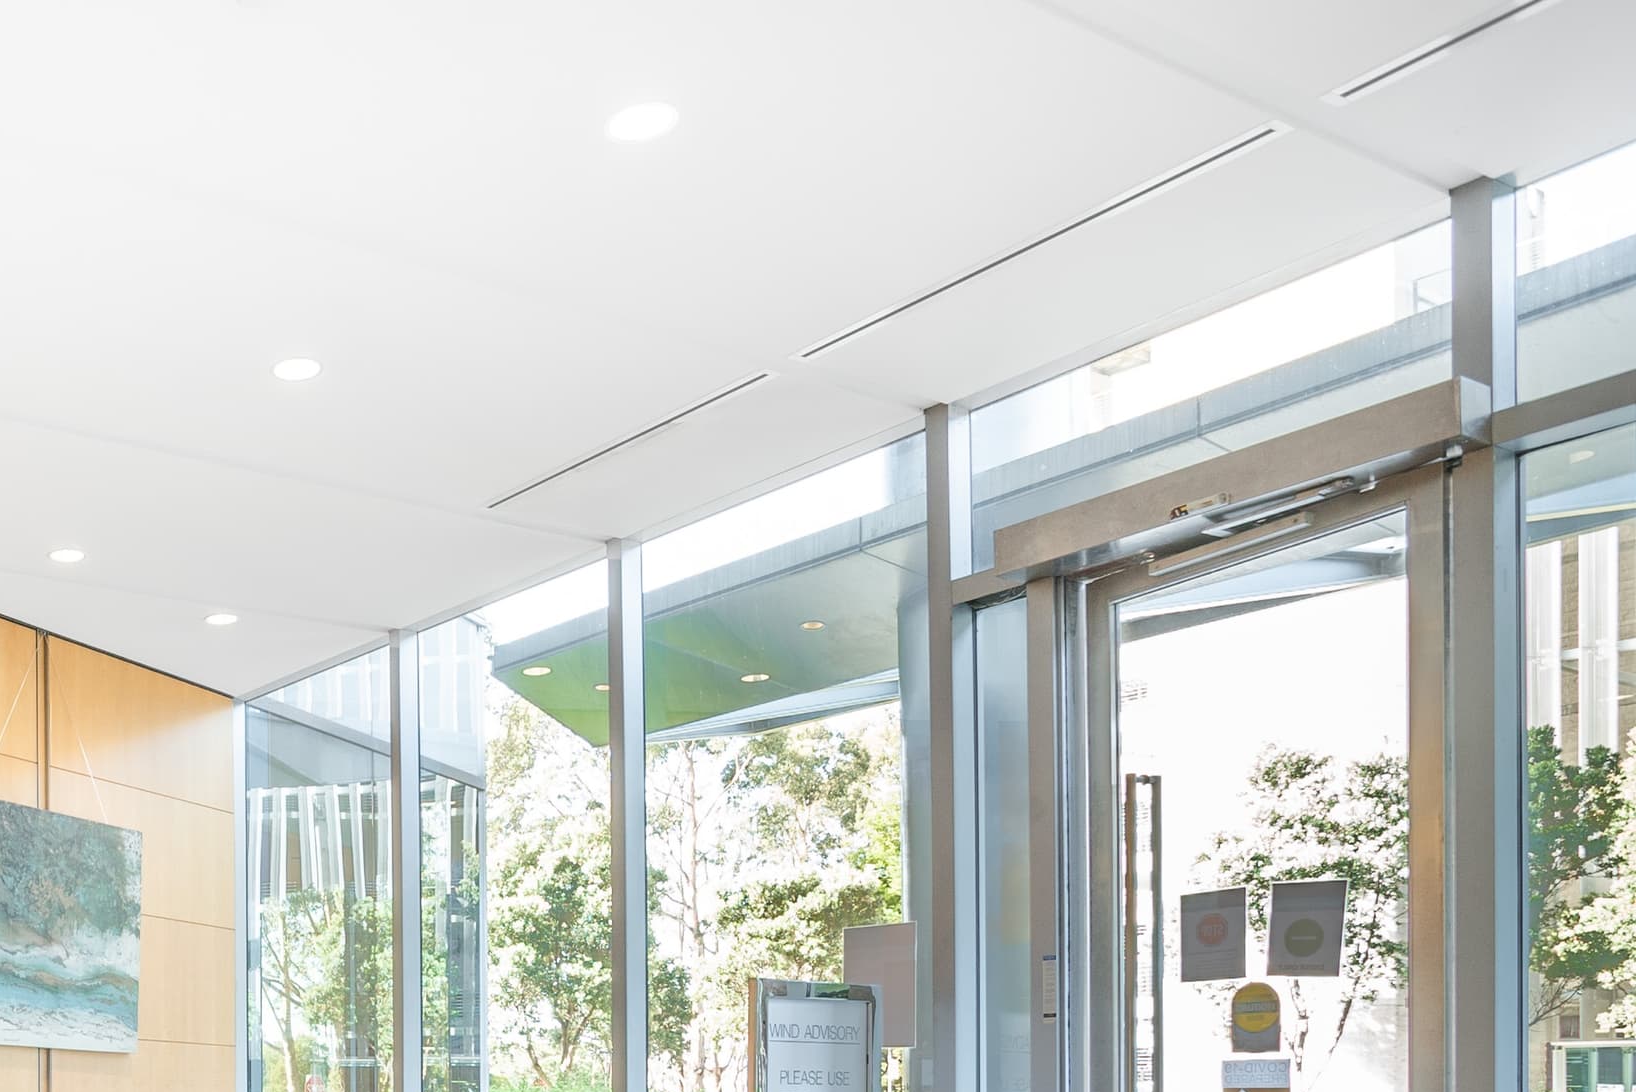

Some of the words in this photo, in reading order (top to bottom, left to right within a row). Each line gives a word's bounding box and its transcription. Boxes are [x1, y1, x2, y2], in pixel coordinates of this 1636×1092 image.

[769, 1023, 800, 1039] WIND
[804, 1024, 861, 1040] ADVISORY
[779, 1070, 823, 1086] PLEASE
[827, 1071, 851, 1086] USE
